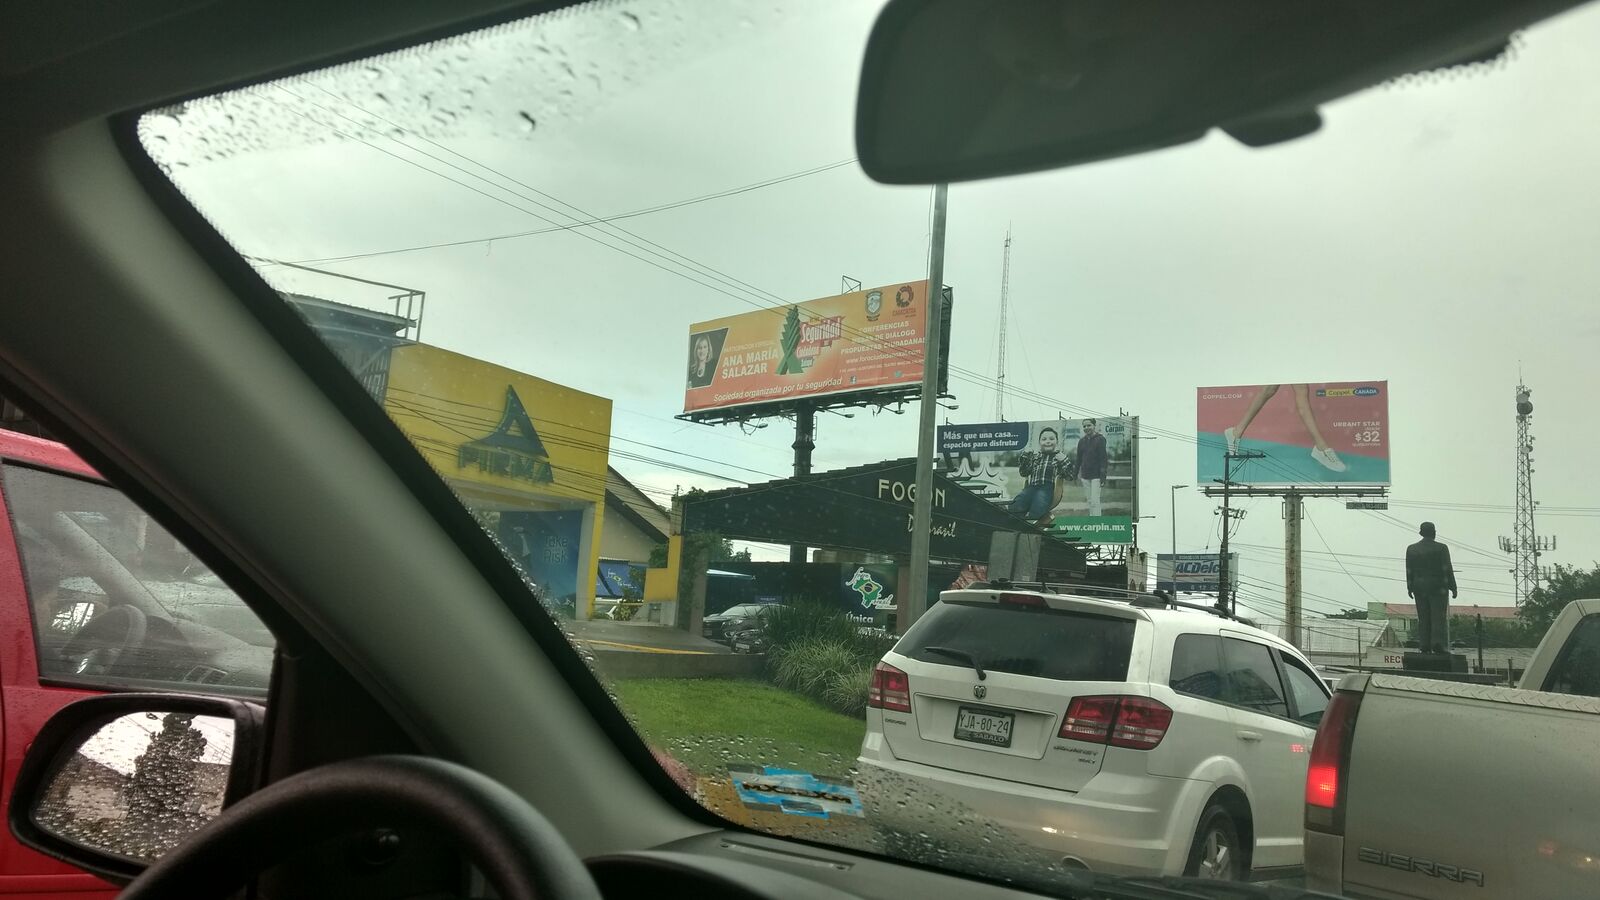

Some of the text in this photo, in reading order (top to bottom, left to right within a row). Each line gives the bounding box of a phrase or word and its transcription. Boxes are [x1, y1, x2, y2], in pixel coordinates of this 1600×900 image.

[722, 355, 744, 367] ANA
[721, 363, 768, 379] SALAZAR
[713, 391, 743, 401] Sociedad
[744, 386, 782, 399] organizada
[782, 384, 795, 394] por
[804, 376, 842, 390] seguridad
[943, 430, 961, 440] Más
[1354, 431, 1381, 443] $32
[943, 438, 1019, 450] espacios para disfrutar
[1059, 522, 1125, 532] www.carpin.mx
[960, 713, 1010, 735] YJA-80-24
[1358, 846, 1485, 888] SIERRA
